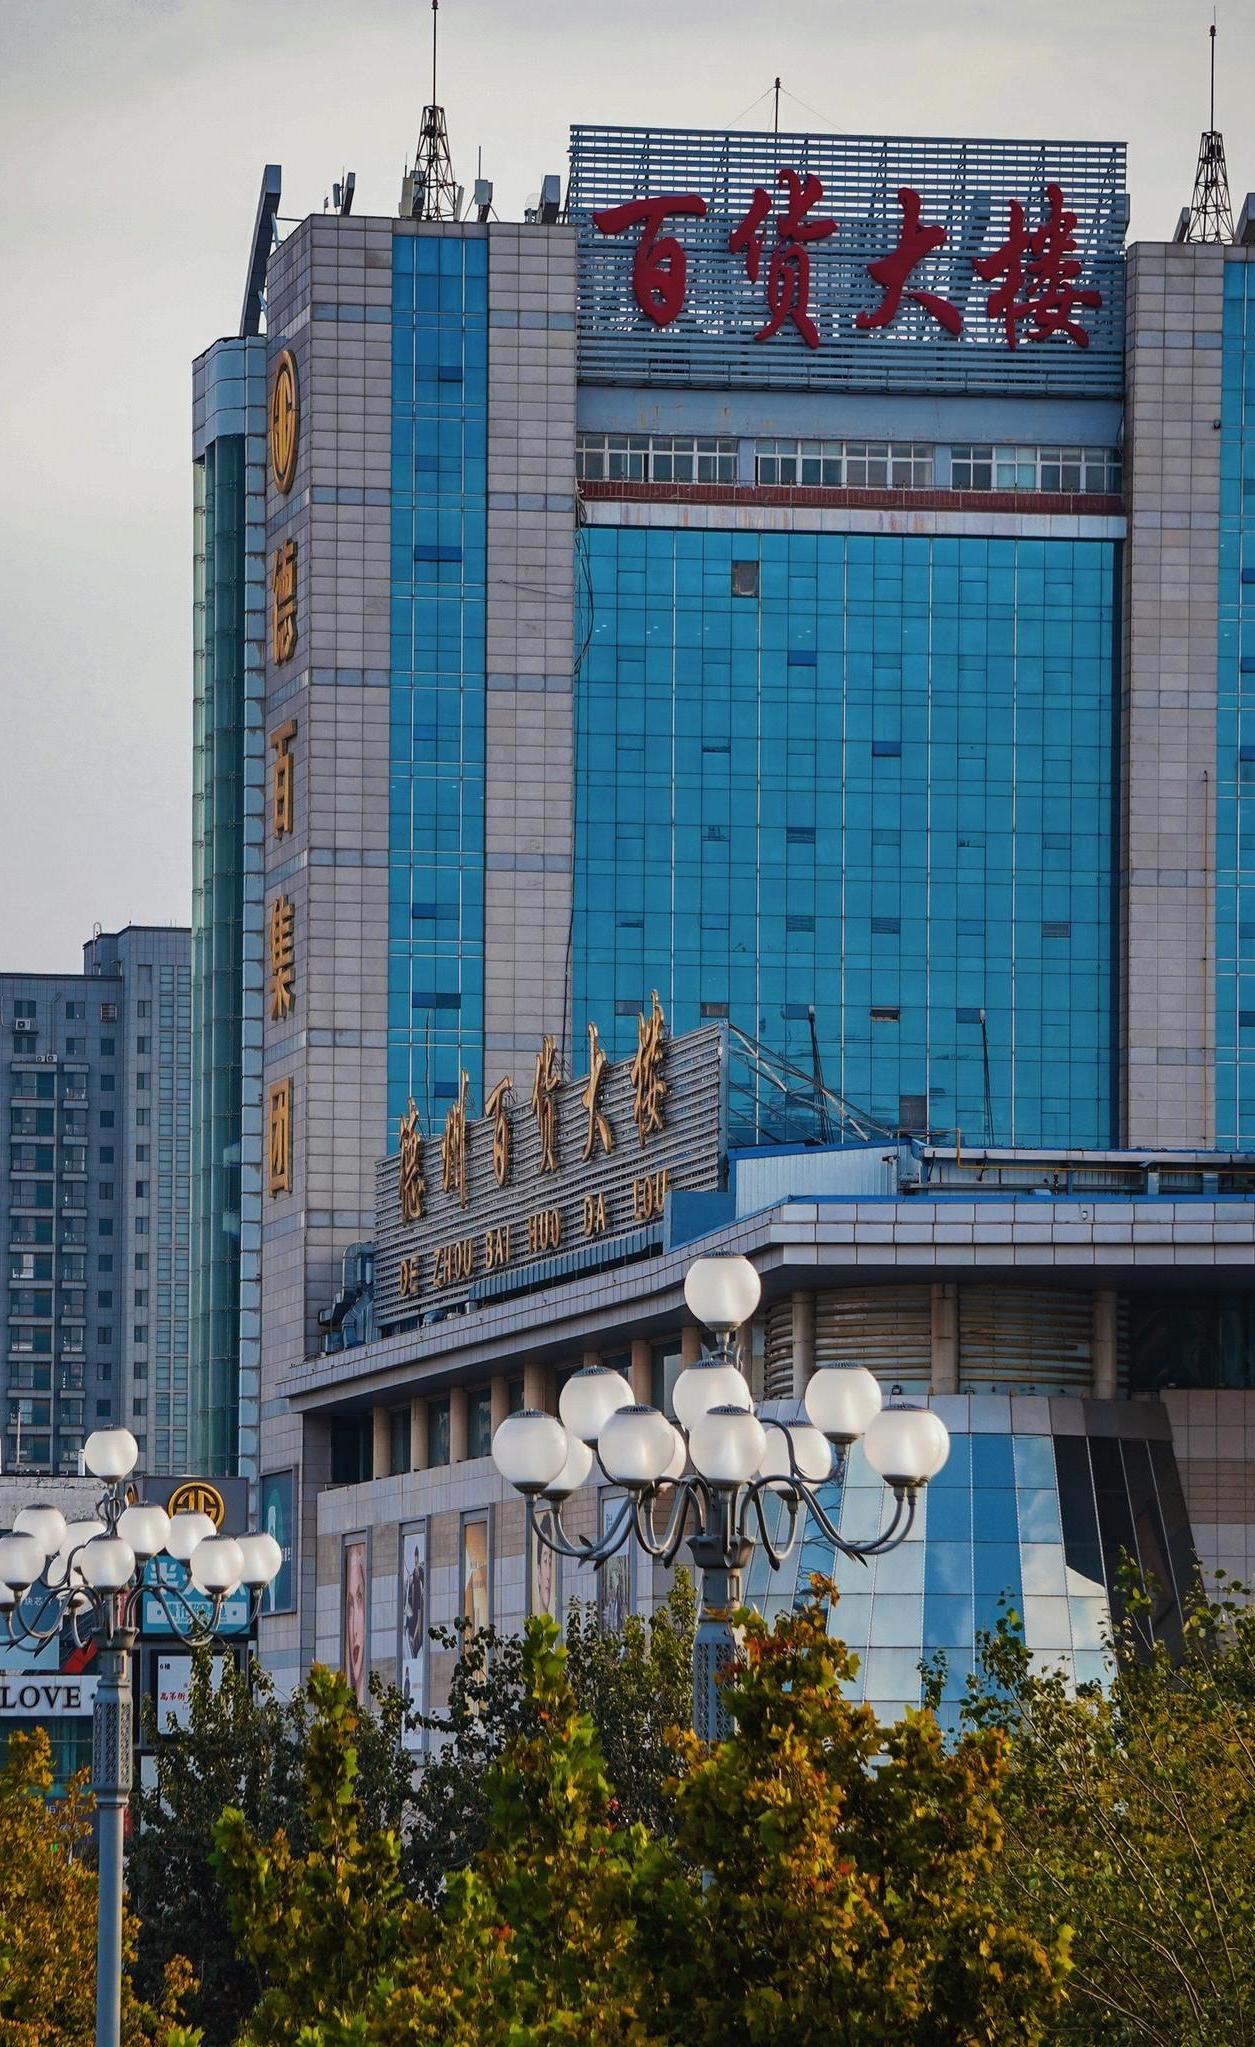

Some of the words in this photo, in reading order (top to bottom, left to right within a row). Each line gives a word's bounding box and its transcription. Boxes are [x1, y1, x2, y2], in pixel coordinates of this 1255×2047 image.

[592, 169, 1101, 352] 百货大楼
[270, 538, 299, 1199] 德百集团
[399, 989, 670, 1222] 德州百货大楼
[399, 1252, 421, 1297] DE
[433, 1236, 474, 1289] ZHOU
[485, 1223, 512, 1270] BAI
[528, 1207, 561, 1254] HUO
[583, 1191, 609, 1238] DA
[633, 1169, 669, 1222] LOU
[0, 1685, 81, 1709] LOVE
